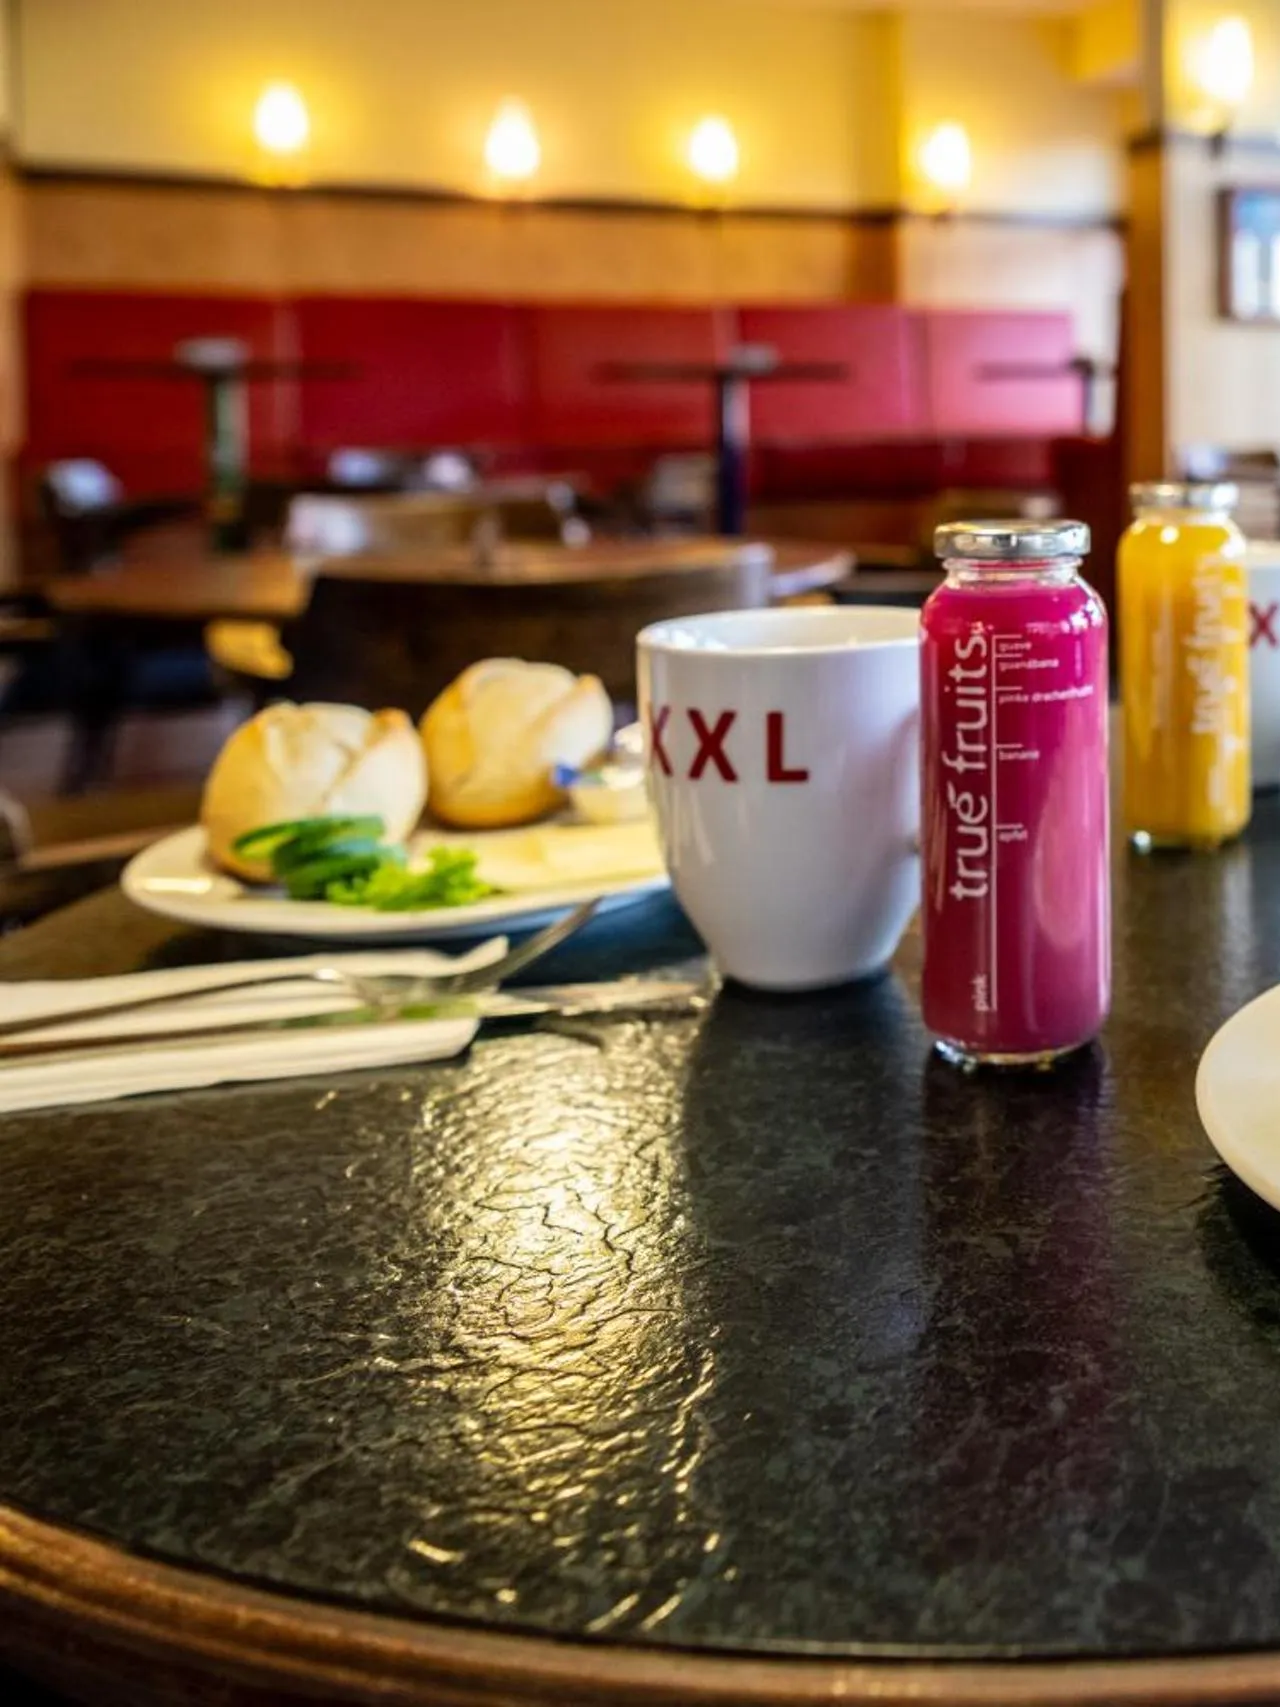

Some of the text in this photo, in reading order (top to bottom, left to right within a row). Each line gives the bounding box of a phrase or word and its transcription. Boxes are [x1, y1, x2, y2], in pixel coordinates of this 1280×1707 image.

[942, 635, 989, 900] true fruits
[970, 973, 990, 1012] pink
